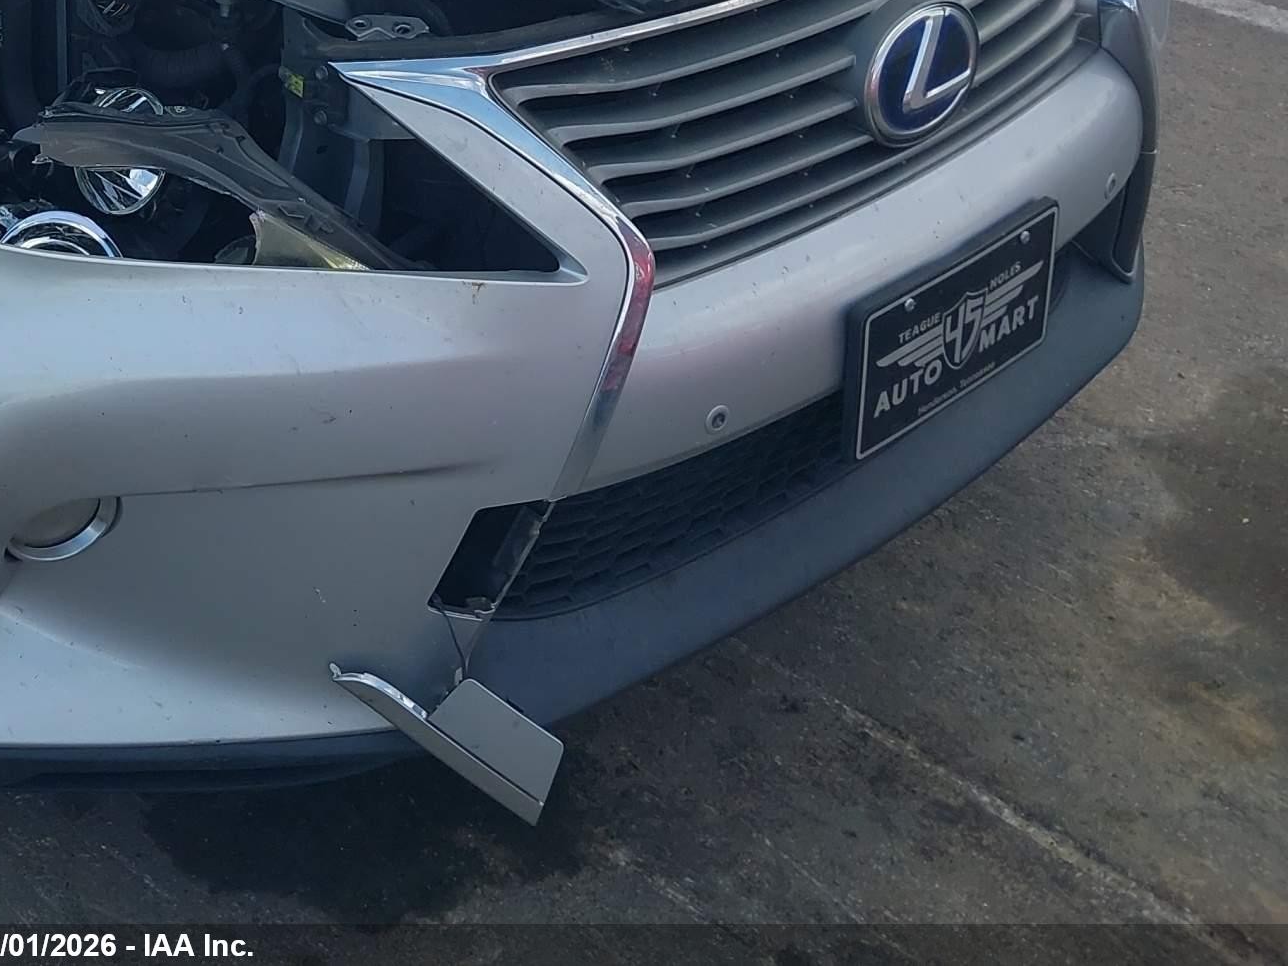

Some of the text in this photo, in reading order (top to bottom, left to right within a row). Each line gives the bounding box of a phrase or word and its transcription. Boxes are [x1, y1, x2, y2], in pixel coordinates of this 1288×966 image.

[873, 359, 942, 418] AUTO
[978, 295, 1039, 352] MART
[898, 312, 941, 344] TEAGUE
[944, 295, 985, 364] 45
